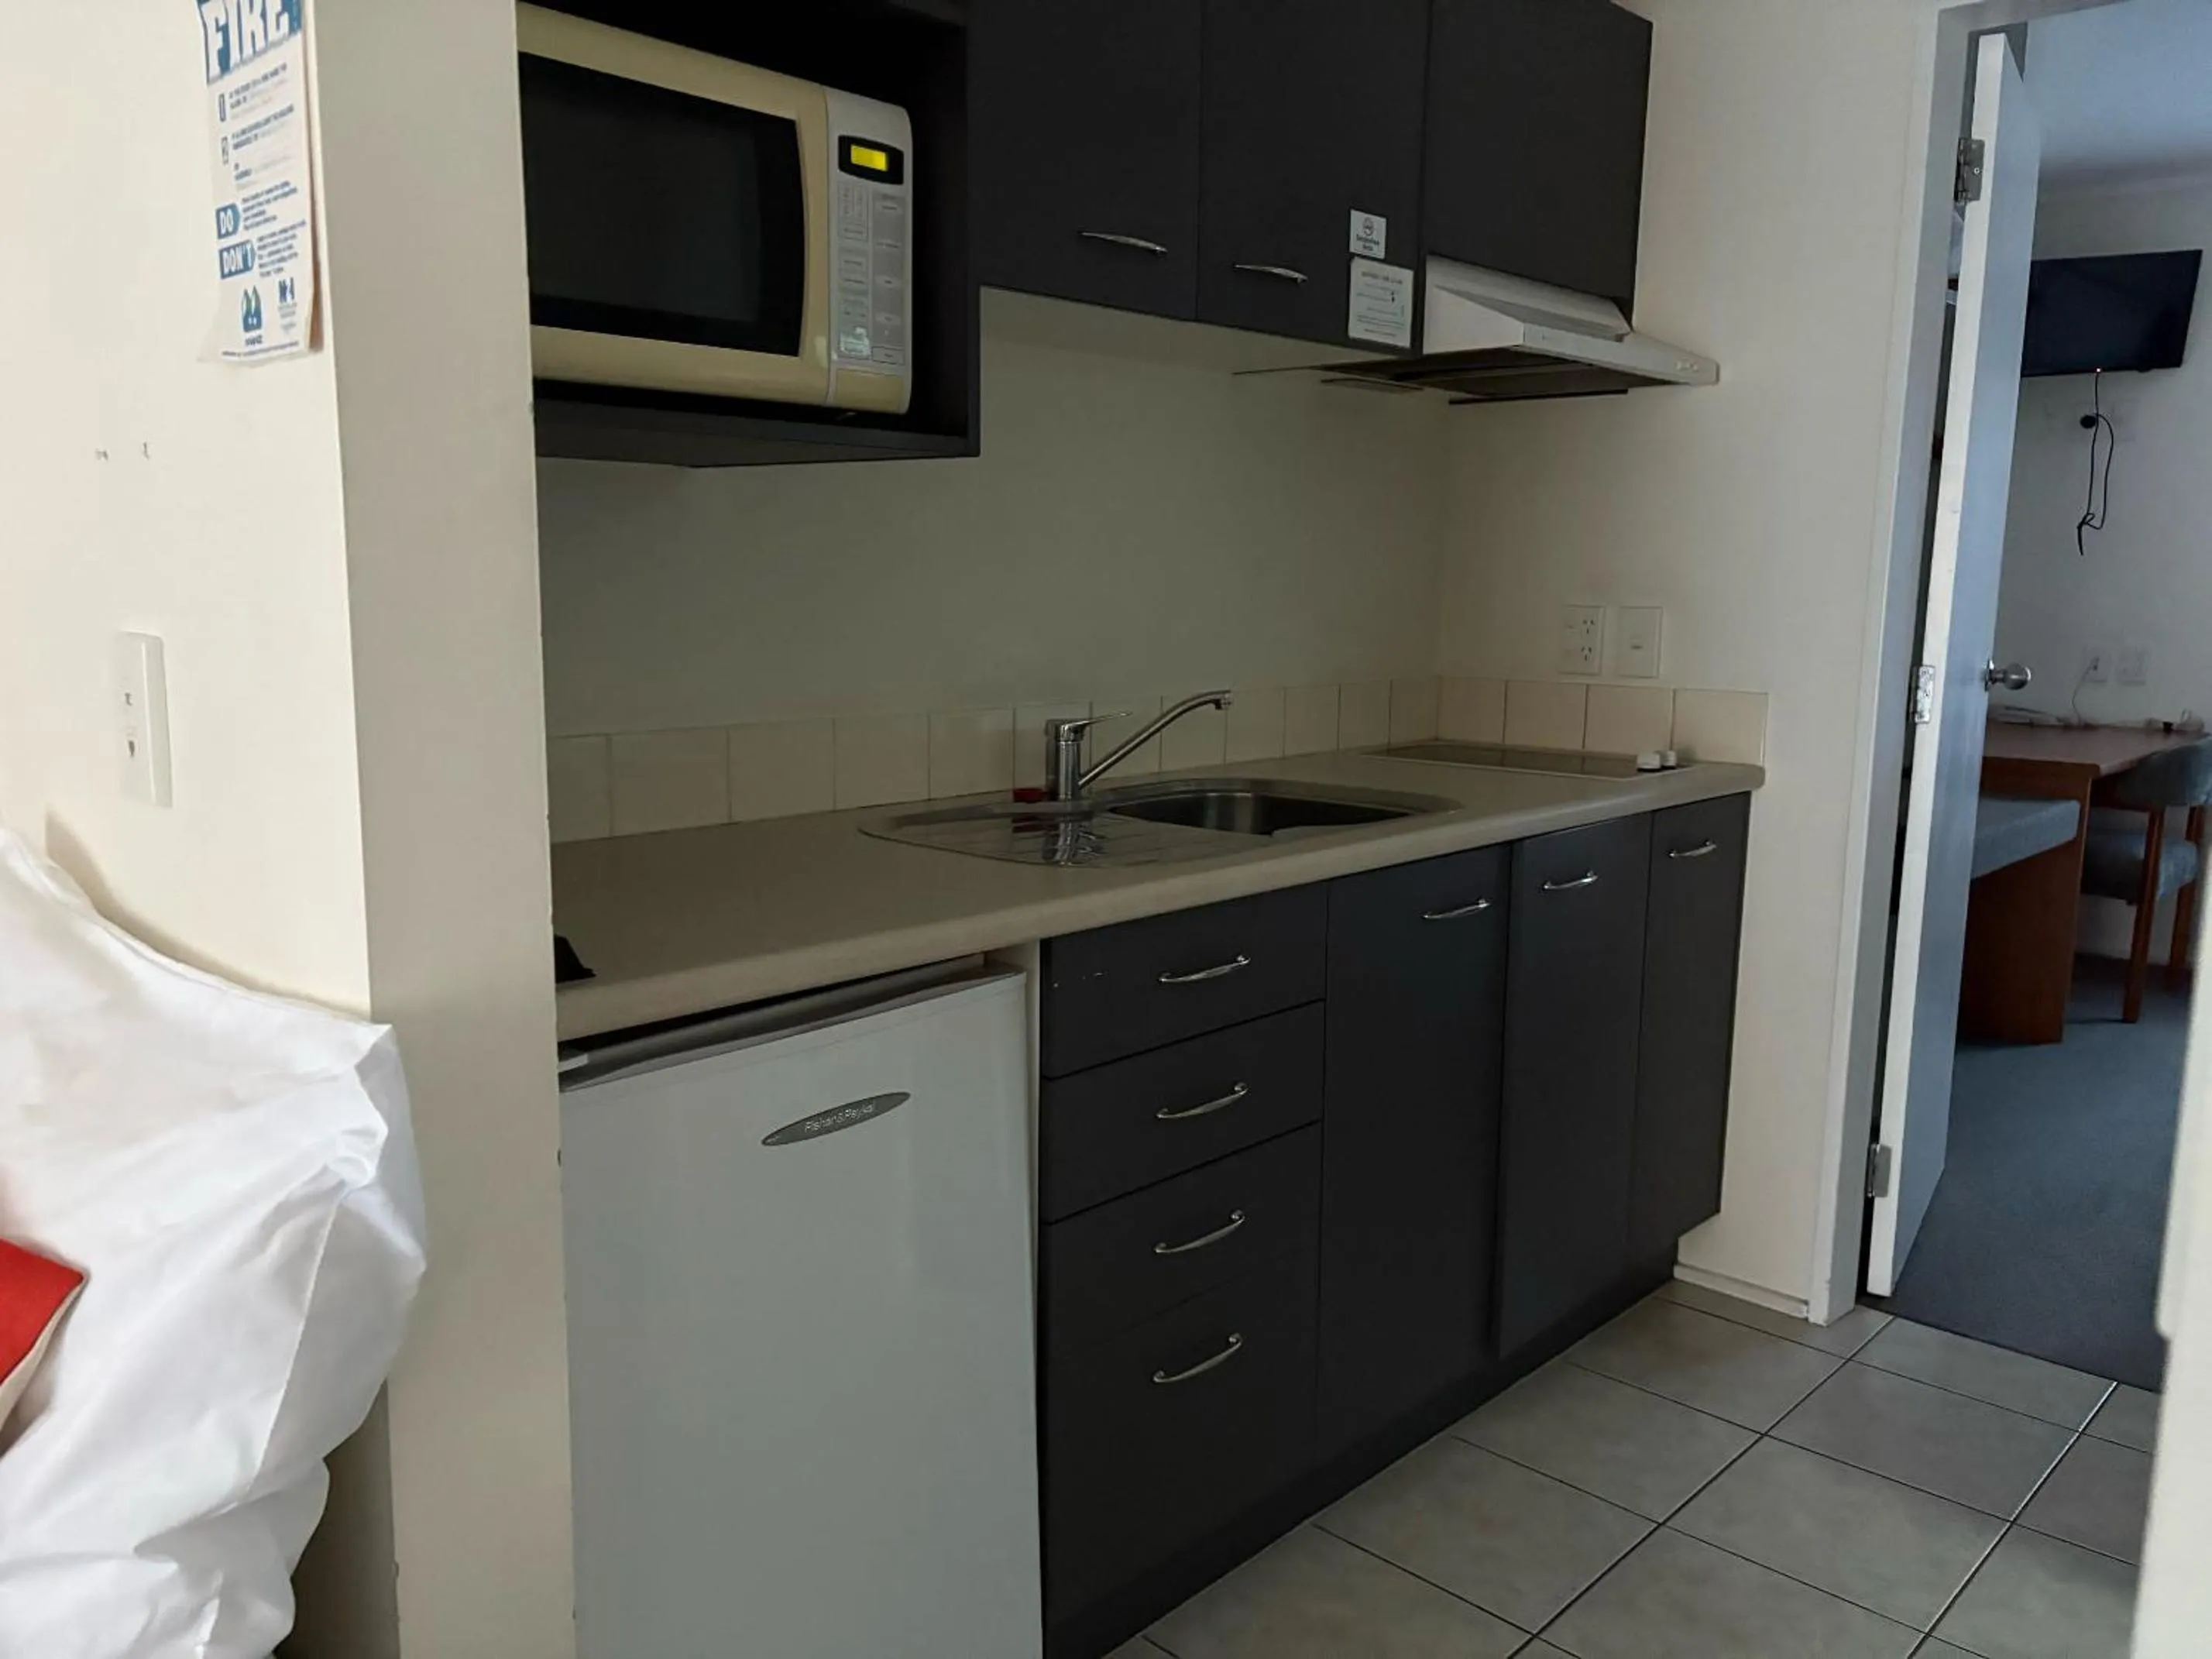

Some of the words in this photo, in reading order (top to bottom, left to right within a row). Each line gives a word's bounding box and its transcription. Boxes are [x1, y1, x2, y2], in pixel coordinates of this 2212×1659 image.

[199, 0, 290, 81] FIRE
[219, 208, 234, 235] DO
[222, 243, 252, 276] DON'T
